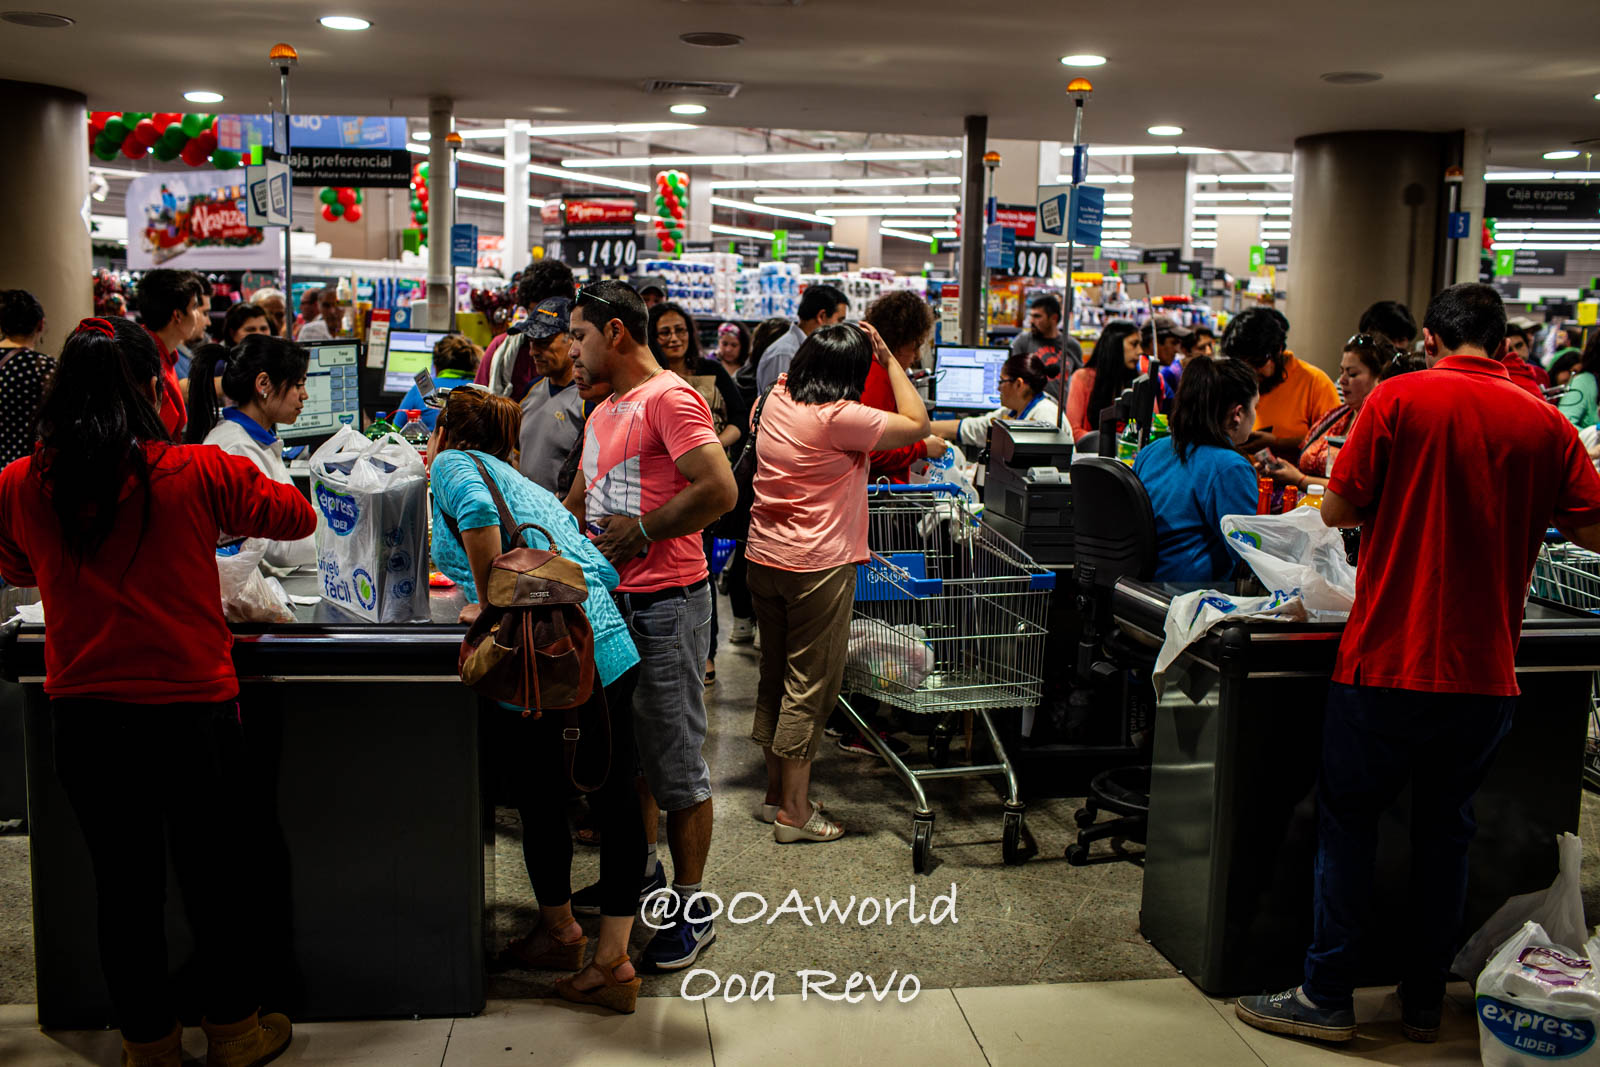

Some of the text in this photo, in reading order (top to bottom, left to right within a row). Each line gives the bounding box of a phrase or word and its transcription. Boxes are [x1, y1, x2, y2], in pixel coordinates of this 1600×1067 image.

[313, 154, 392, 168] preferencial
[1506, 187, 1575, 203] Caja express
[589, 239, 637, 267] 1490
[1007, 250, 1048, 278] 990
[324, 574, 352, 603] fácil
[1482, 1003, 1587, 1041] express
[1514, 1035, 1556, 1054] LIDER
